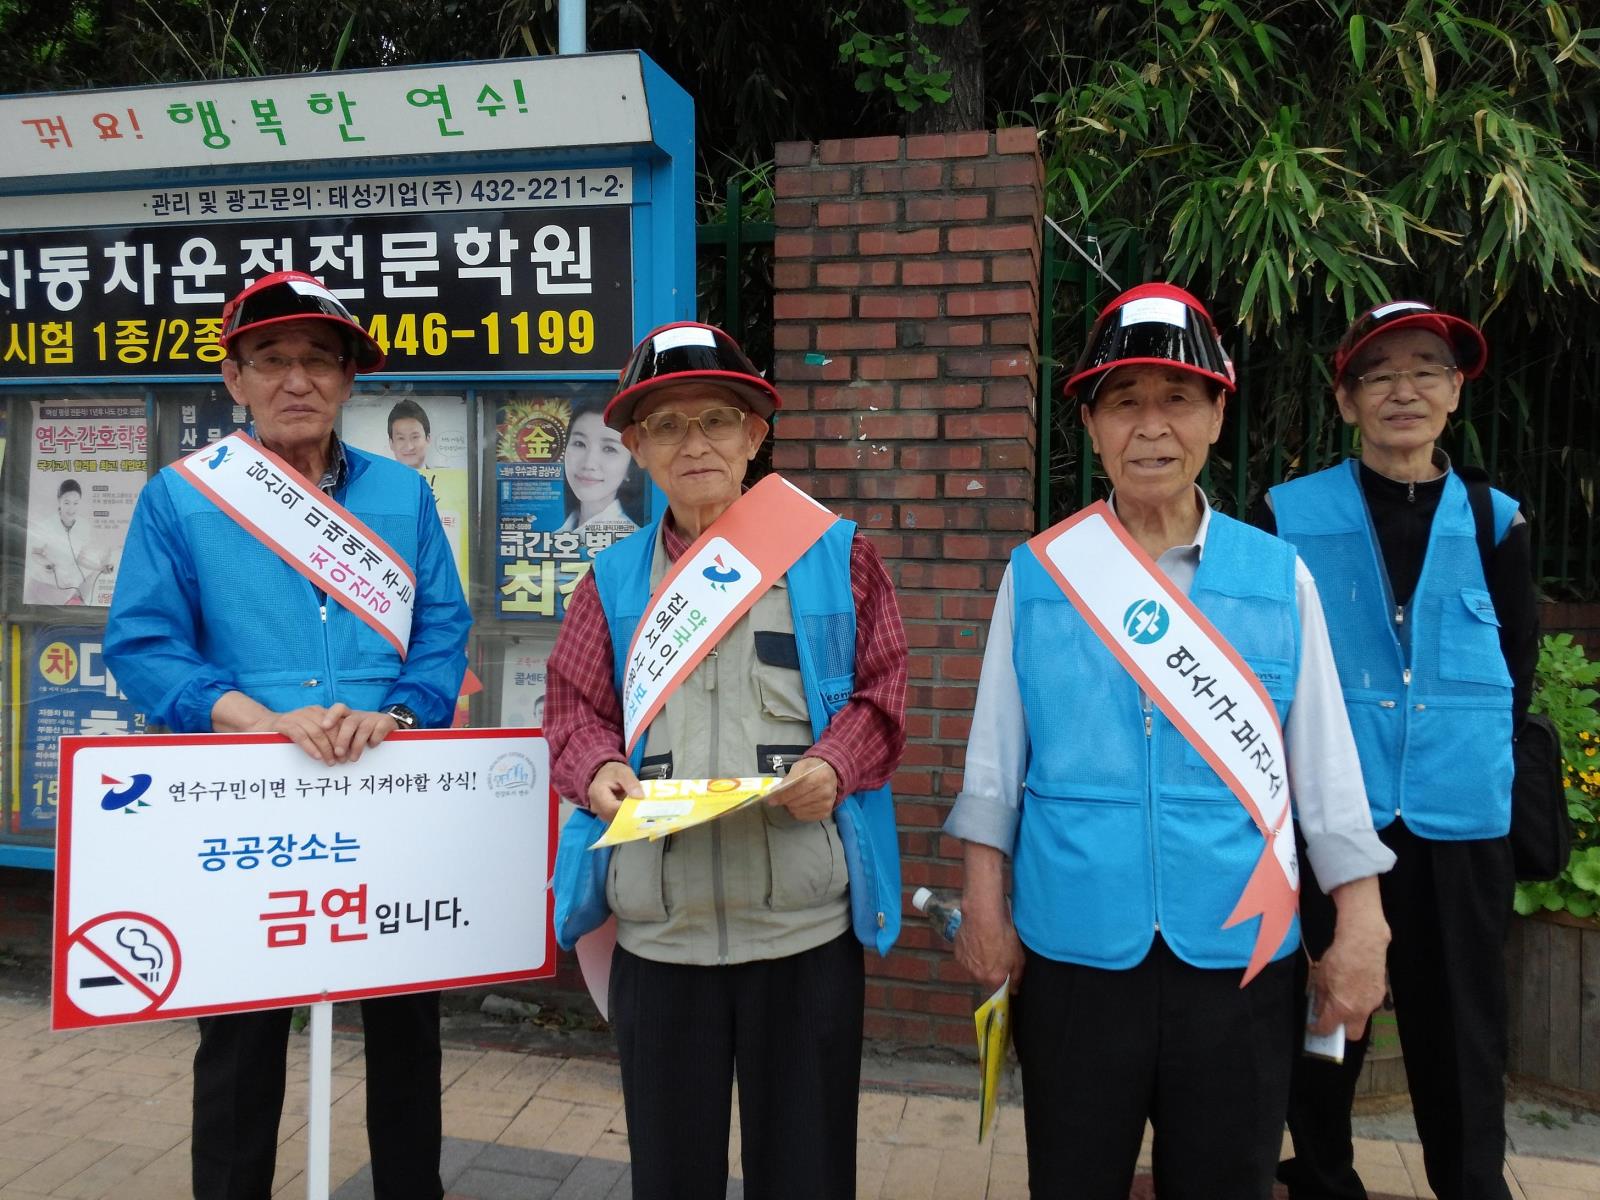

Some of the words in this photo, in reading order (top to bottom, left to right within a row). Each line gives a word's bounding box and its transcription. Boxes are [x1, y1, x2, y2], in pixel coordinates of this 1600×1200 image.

[167, 91, 366, 149] 행복한
[406, 79, 529, 137] 연수!
[151, 190, 190, 217] 관리
[198, 190, 218, 215] 및
[328, 179, 463, 211] 태성기업(주)
[470, 174, 620, 203] 432-2211~2
[3, 321, 75, 365] 시험
[92, 317, 228, 364] 1종/2종
[523, 426, 555, 459] 金
[246, 460, 305, 510] 당신의
[304, 505, 383, 571] 미래에게
[382, 568, 412, 604] 주는
[309, 545, 392, 615] 치아건강
[644, 592, 689, 650] 집에서
[647, 608, 708, 683] 약국이나
[1166, 645, 1284, 799] 연수구보건소
[167, 777, 288, 805] 연수구민이면
[294, 773, 352, 798] 누구나
[359, 772, 430, 797] 지켜야할
[436, 770, 478, 793] 상식!
[197, 831, 361, 873] 공공장소는
